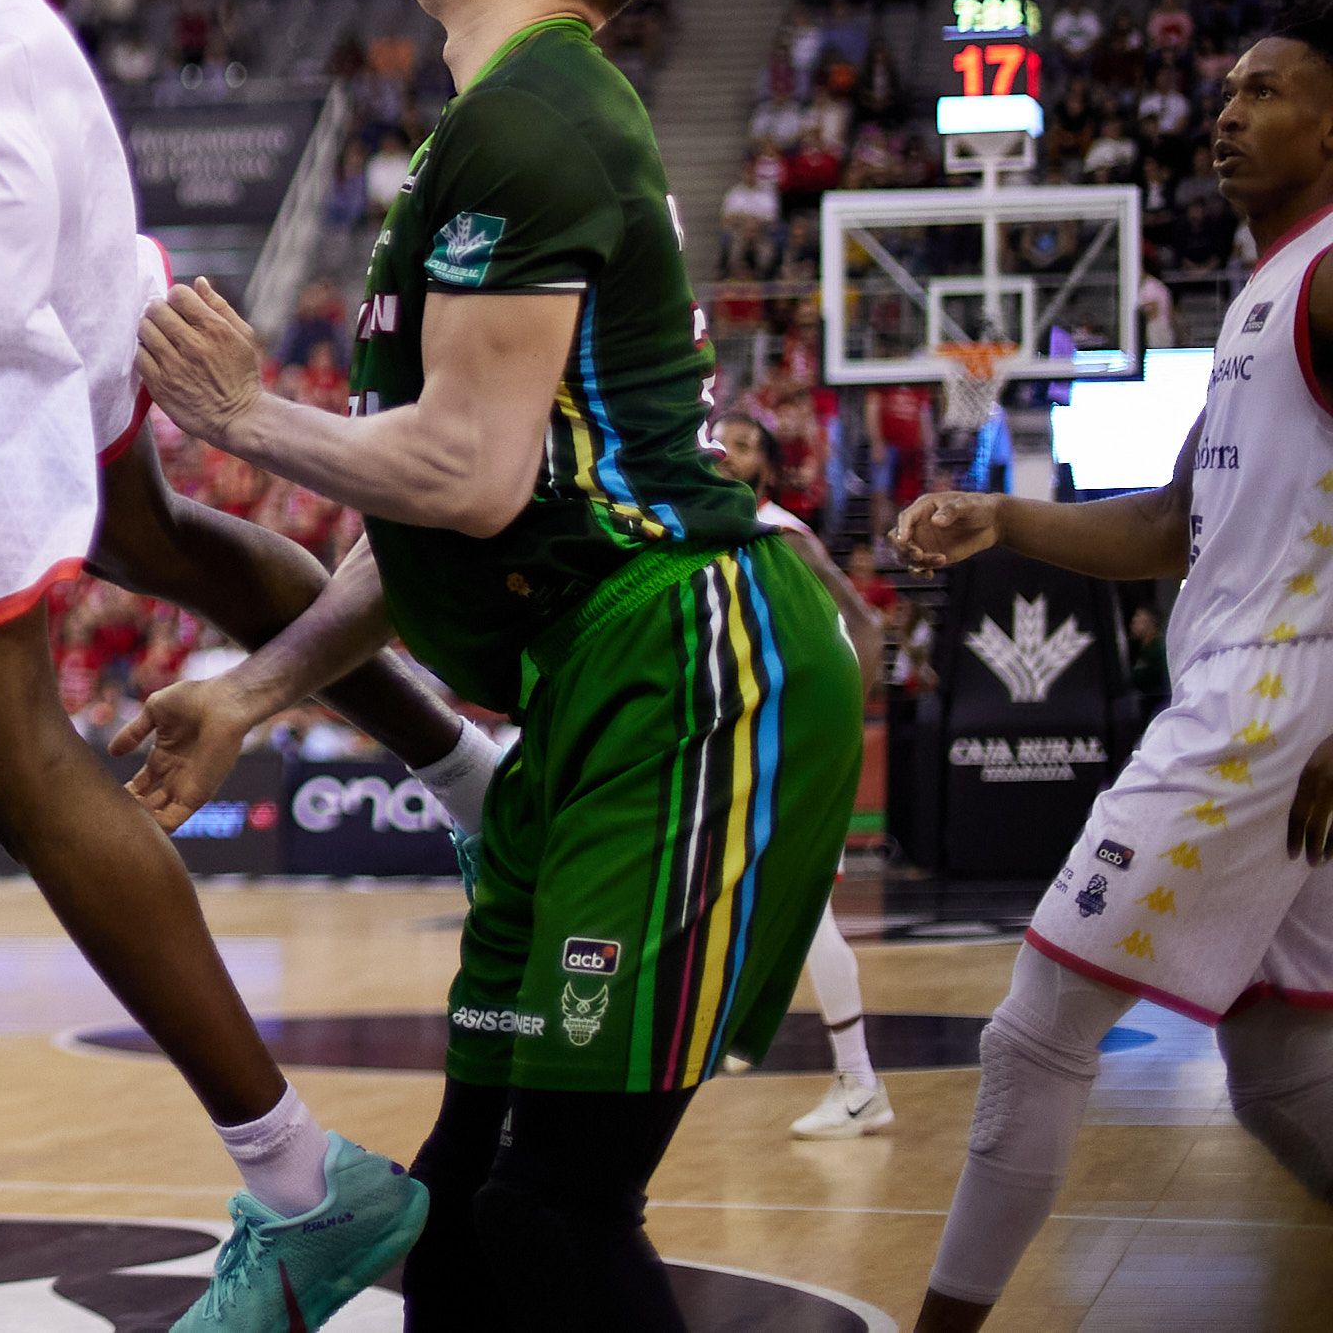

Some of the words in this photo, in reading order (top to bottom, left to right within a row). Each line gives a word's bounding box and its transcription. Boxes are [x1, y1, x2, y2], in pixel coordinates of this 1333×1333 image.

[953, 44, 1026, 97] 17
[1098, 848, 1124, 866] acb
[568, 952, 605, 969] acb
[451, 1006, 518, 1033] asisa
